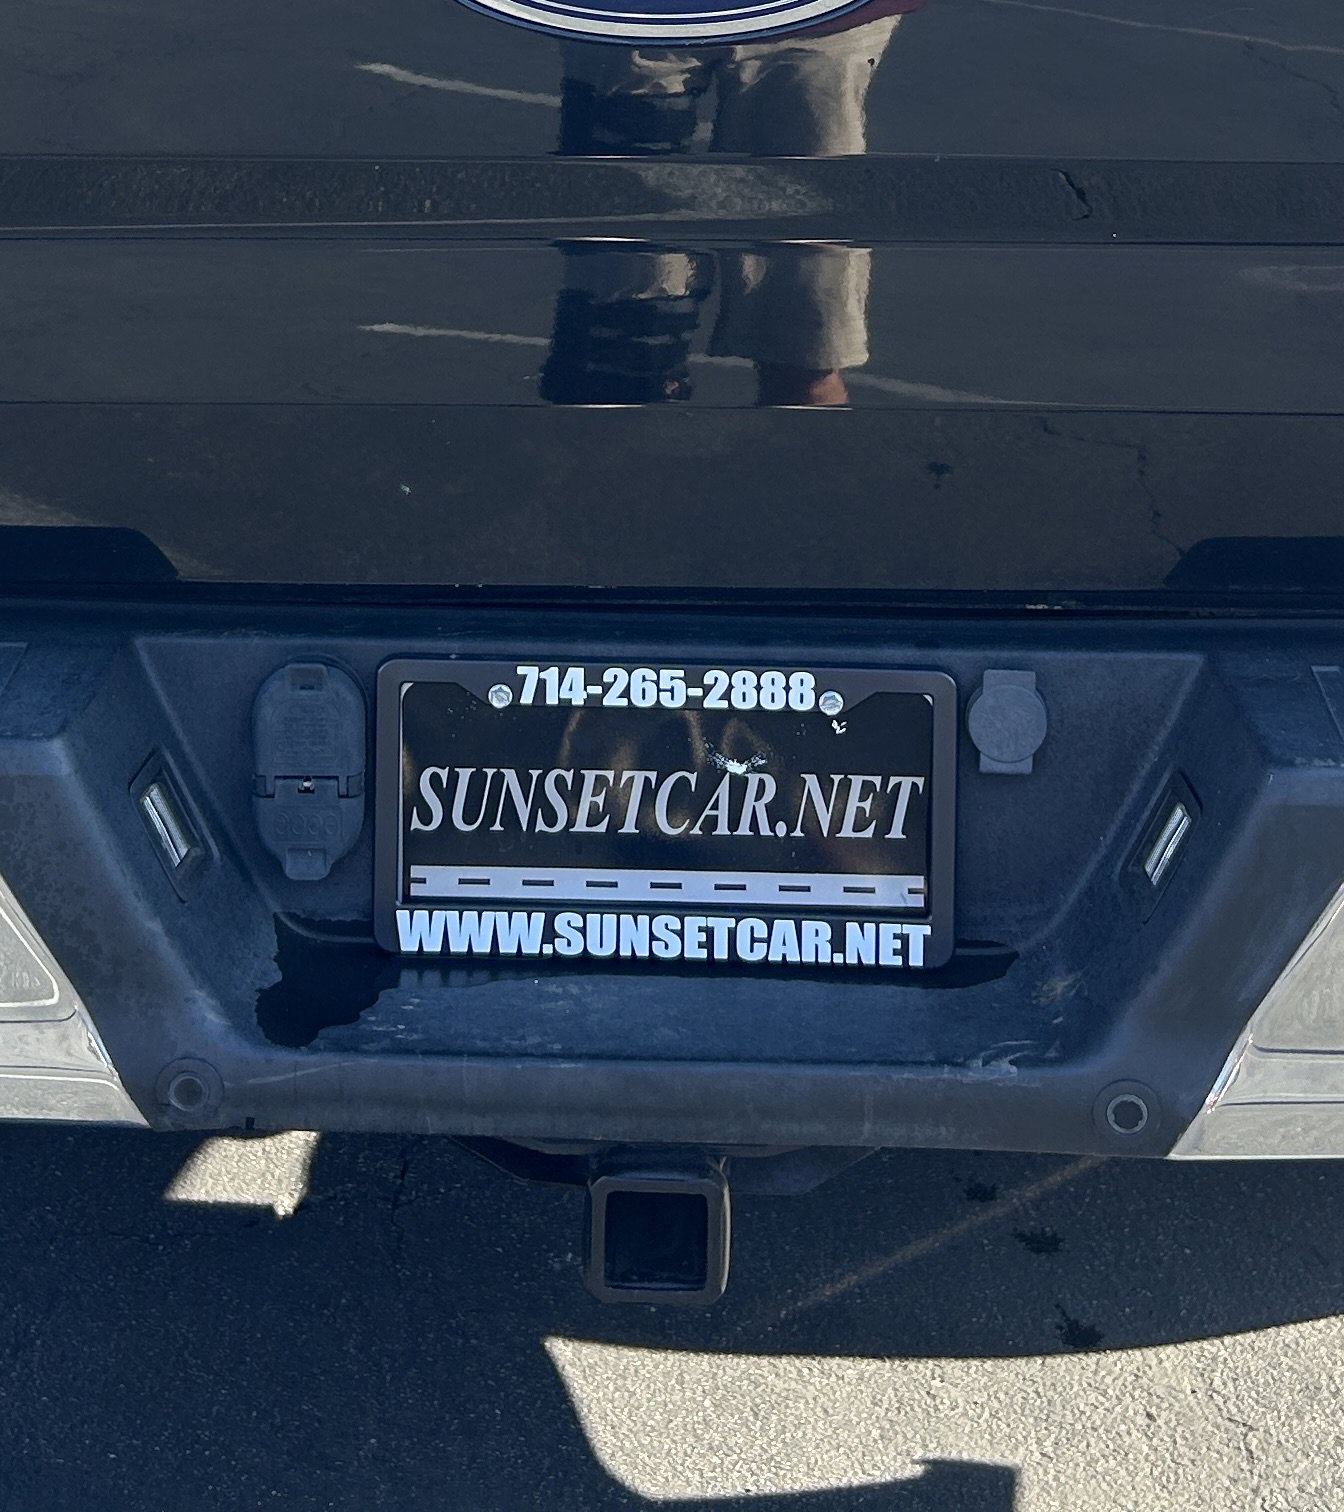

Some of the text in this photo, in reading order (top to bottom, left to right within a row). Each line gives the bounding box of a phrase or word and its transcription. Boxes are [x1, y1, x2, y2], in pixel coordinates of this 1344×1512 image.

[516, 665, 816, 710] 714-265-2888
[410, 766, 925, 839] SUNSETCAR.NET
[395, 909, 932, 967] WWW.SUNSETCAR.NET
